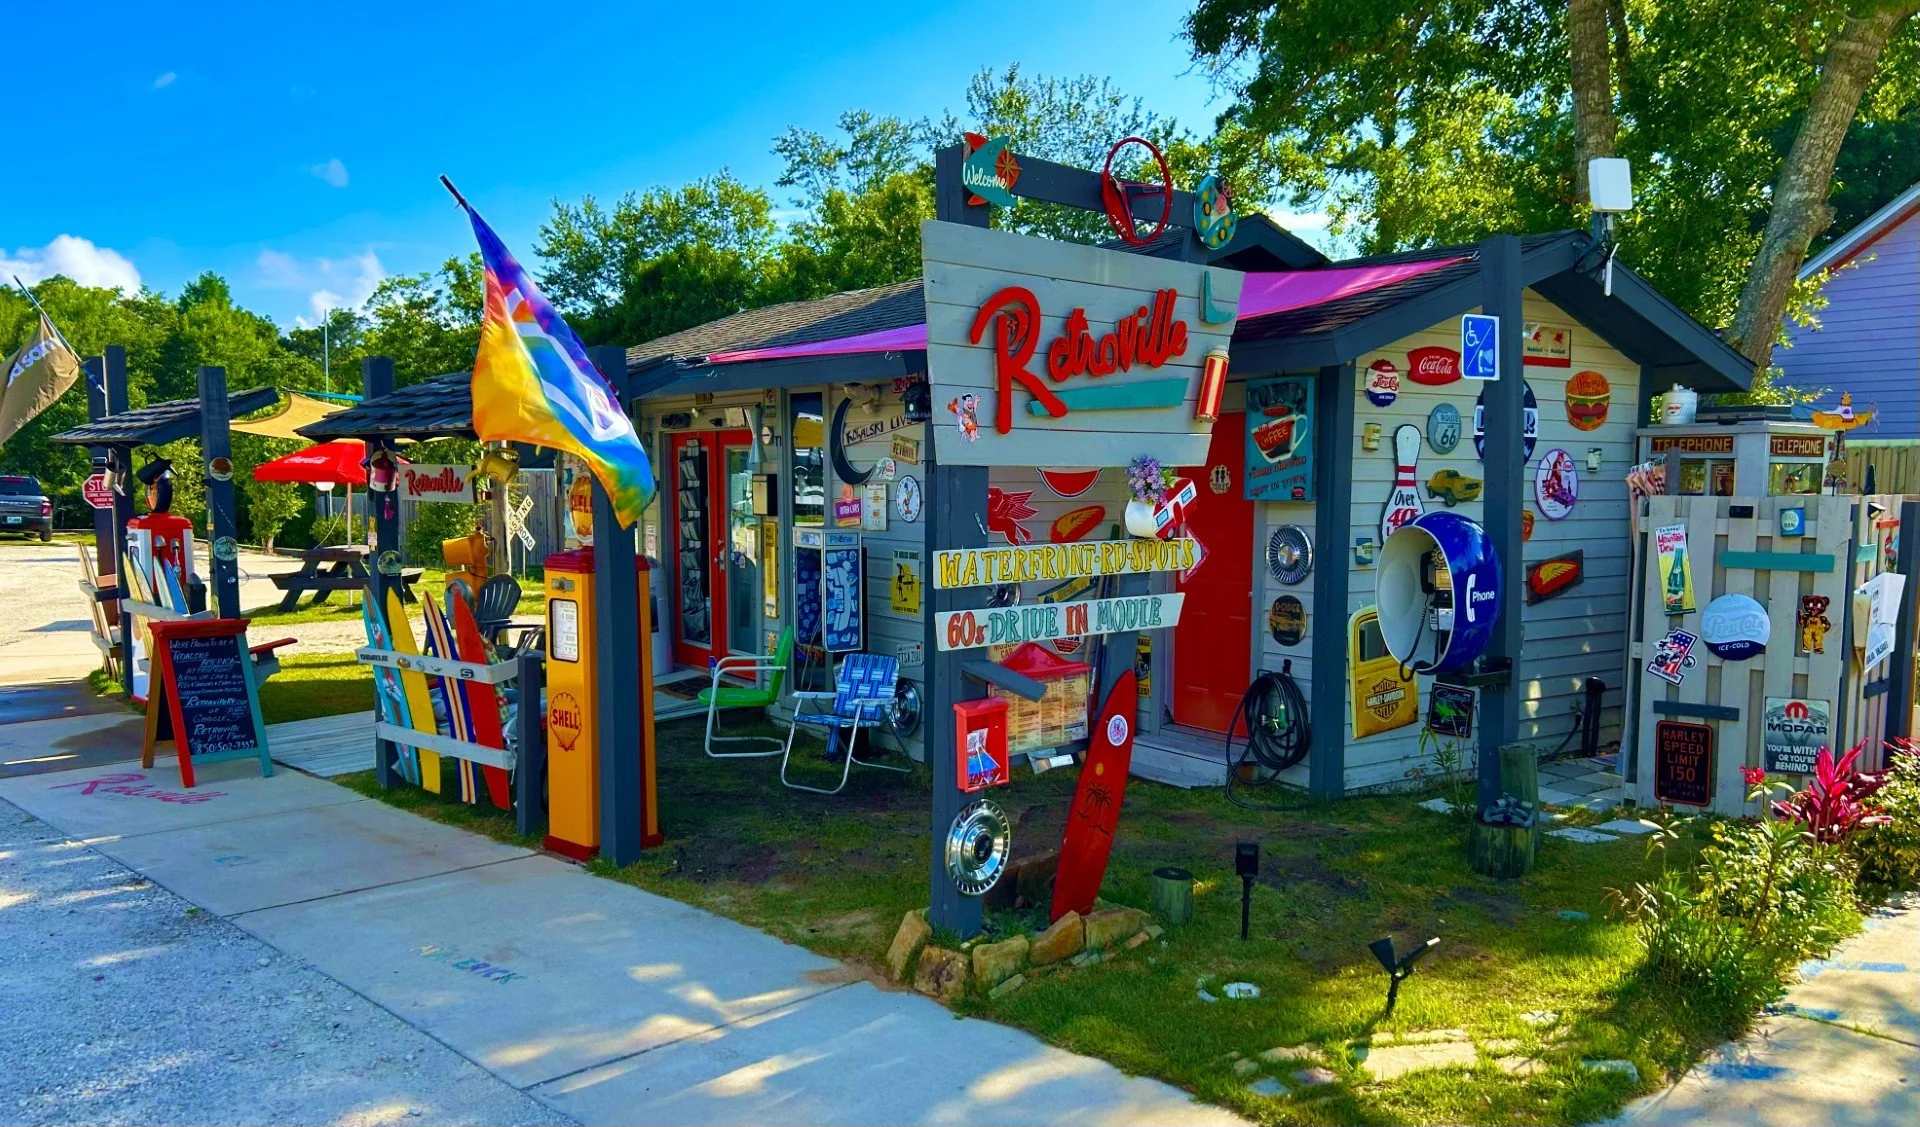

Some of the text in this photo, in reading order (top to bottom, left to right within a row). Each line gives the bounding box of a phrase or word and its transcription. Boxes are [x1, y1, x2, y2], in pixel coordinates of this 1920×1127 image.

[962, 162, 1008, 190] Welcome
[969, 286, 1188, 434] Retroville
[1441, 428, 1457, 446] 66
[1655, 438, 1731, 451] TELEPHONE
[1771, 439, 1822, 454] TELEPHONE
[1394, 490, 1415, 506] Over
[1659, 544, 1674, 553] Dew
[940, 545, 1096, 588] WATERFRONT
[1472, 590, 1495, 602] Phone
[1065, 603, 1089, 636] IN
[1374, 680, 1397, 692] MOTOR
[1374, 703, 1398, 718] CYCLES
[552, 708, 579, 730] SHELL
[1663, 729, 1705, 742] HARLEY
[1767, 722, 1827, 735] MOPAR
[1664, 741, 1704, 755] SPEED
[1767, 744, 1817, 755] YOU'RE WITH
[1667, 753, 1699, 766] LIMIT
[1775, 761, 1808, 772] BEHIND
[1790, 755, 1816, 764] YOU'RE
[1670, 766, 1695, 782] 150
